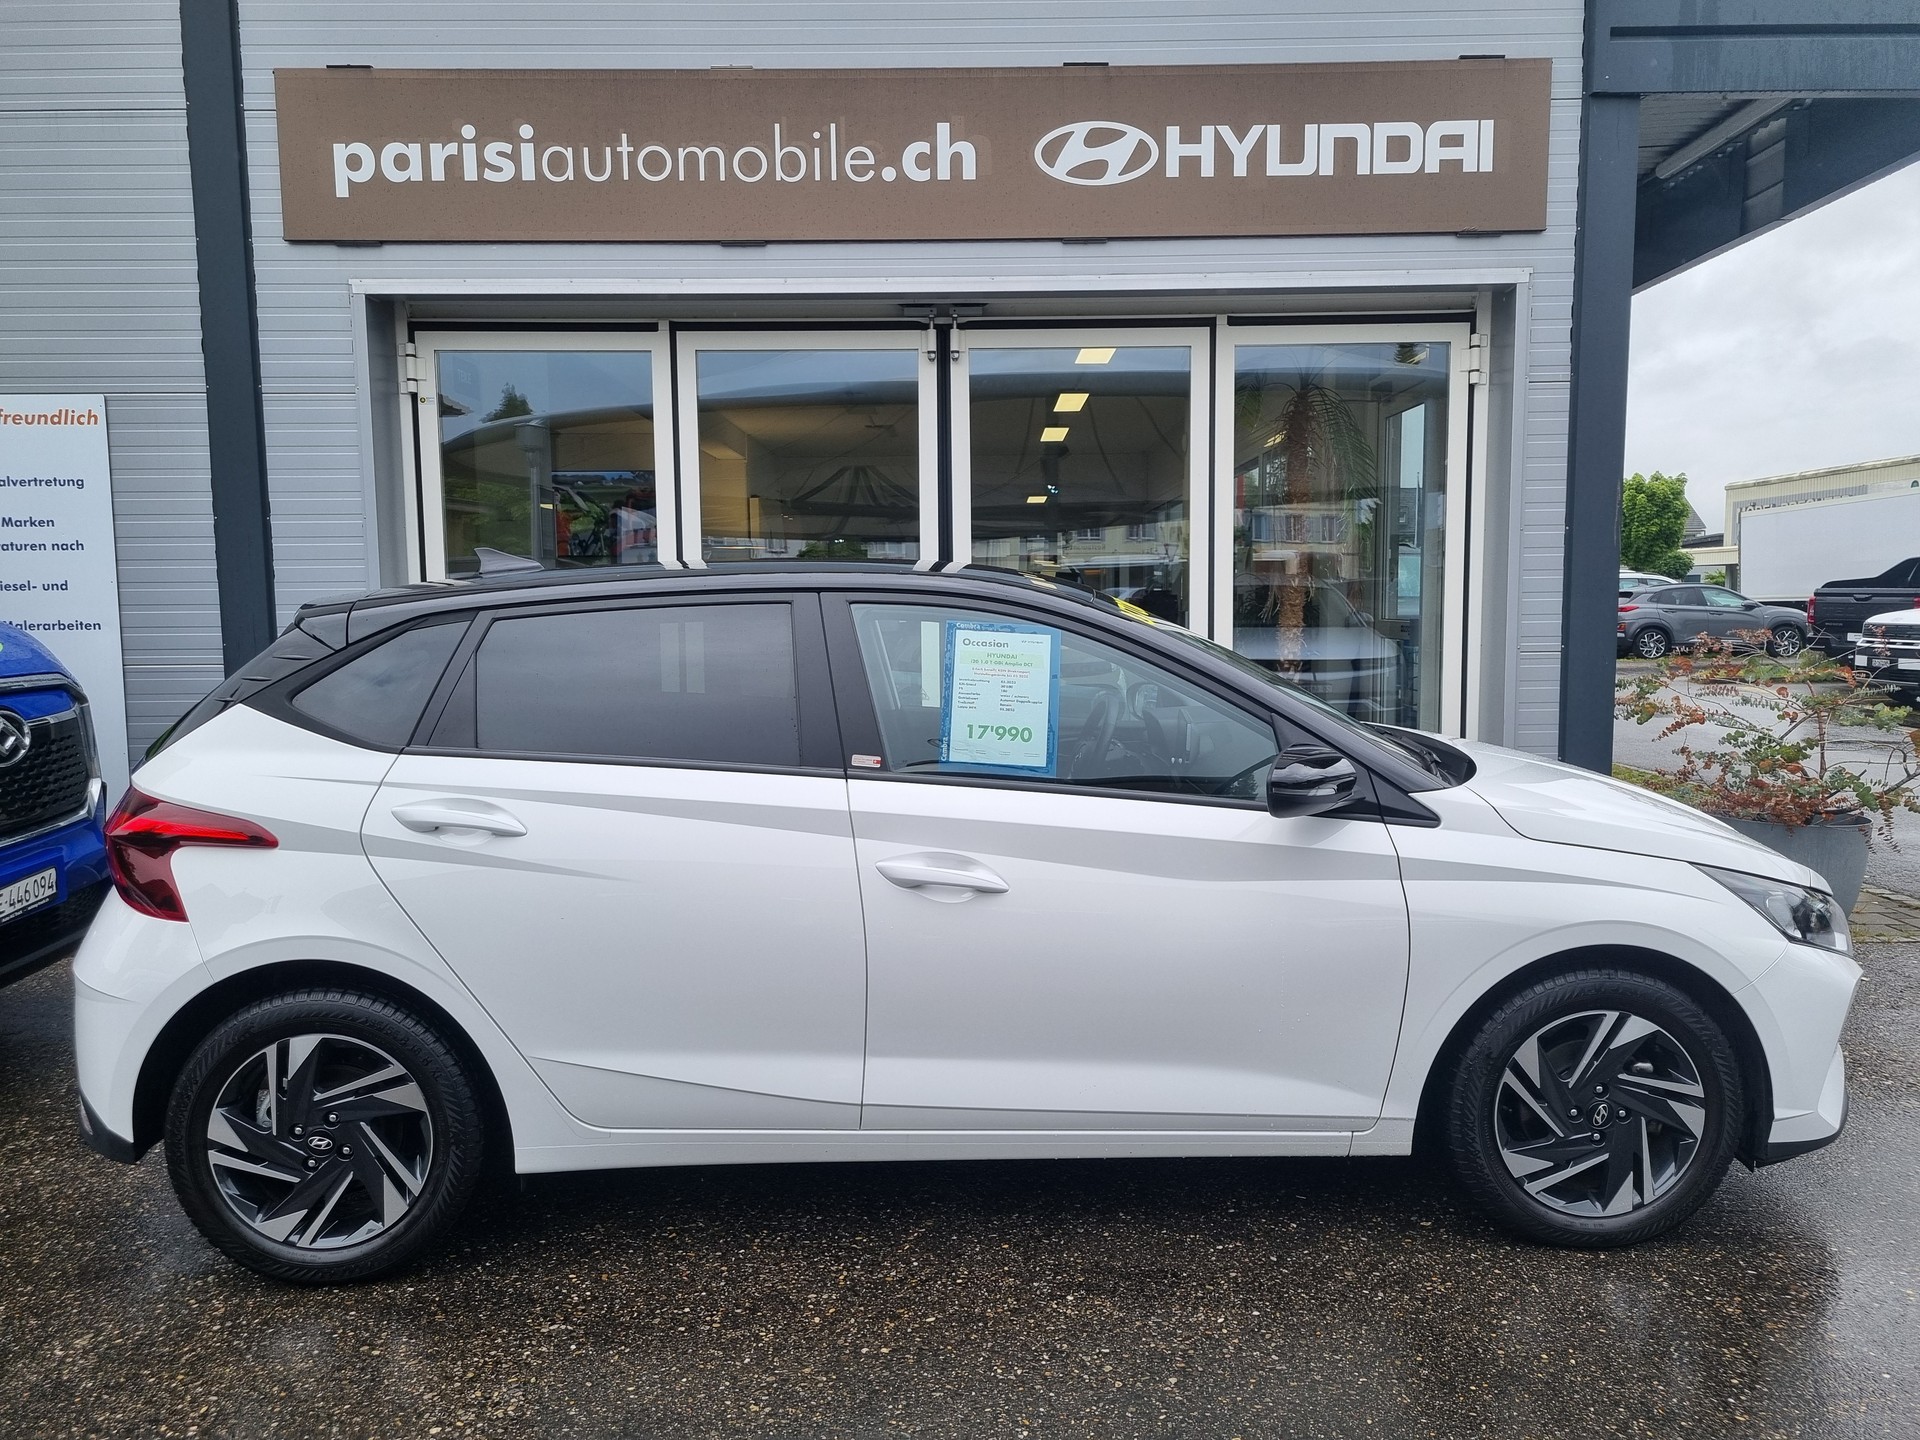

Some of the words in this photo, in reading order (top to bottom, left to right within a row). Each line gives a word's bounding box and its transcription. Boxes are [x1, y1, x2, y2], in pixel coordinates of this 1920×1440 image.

[1166, 119, 1495, 177] HYUNDAI
[333, 122, 977, 198] parisiautomobile.ch
[1, 516, 55, 528] Marken
[0, 541, 47, 551] aturen
[51, 539, 85, 551] nach
[42, 580, 69, 591] und
[963, 637, 1009, 648] Occasion
[987, 652, 1018, 660] HYUNDAI
[967, 724, 1033, 743] 17'990
[941, 736, 949, 761] Cembra
